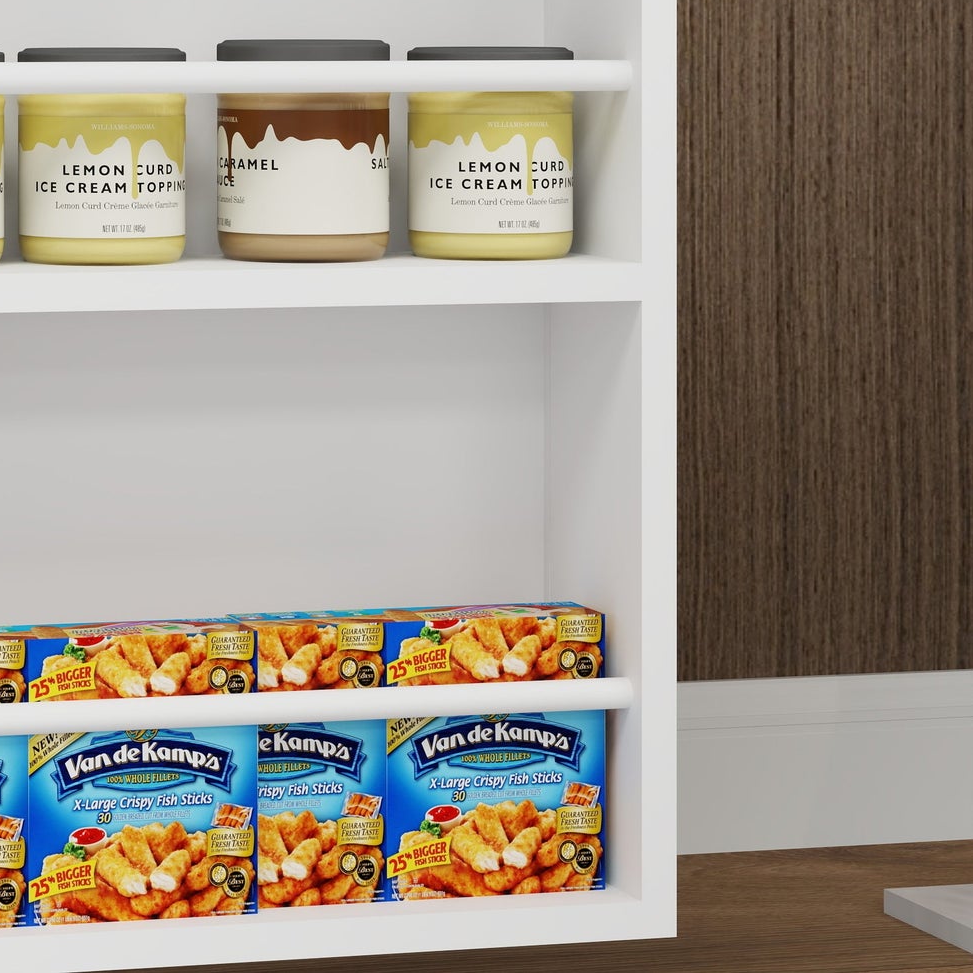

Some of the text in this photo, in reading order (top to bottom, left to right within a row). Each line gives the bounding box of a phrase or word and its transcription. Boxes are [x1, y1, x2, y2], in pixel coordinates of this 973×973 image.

[62, 164, 173, 176] LEMON CURD
[458, 160, 564, 172] LEMON CURD
[35, 179, 186, 194] ICE CREAM TOPPING
[429, 178, 452, 189] ICE
[461, 178, 522, 190] CREAM
[55, 201, 80, 210] Lemon
[81, 201, 102, 210] Curd
[451, 197, 476, 206] Lemon
[477, 197, 497, 206] Curd
[559, 619, 599, 627] GUARANTEED
[341, 627, 381, 636] GUARANTEED
[559, 626, 597, 634] FRESH TASTE
[210, 636, 251, 644] GUARANTEED
[341, 635, 362, 643] FRESH
[210, 642, 249, 651] FRESH TASTE
[2, 652, 21, 660] TASTE
[388, 648, 447, 680] 25% BIGGER
[414, 661, 447, 673] FISH STICKS
[30, 666, 92, 699] 25% BIGGER
[57, 679, 92, 692] FISH STICKS
[390, 717, 411, 736] NEW
[273, 731, 350, 762] Kamp's
[420, 721, 570, 760] Van de Kamp's
[64, 740, 220, 779] Van de Kamp's
[478, 753, 504, 763] WHOLE
[505, 752, 532, 762] FILLETS
[258, 762, 310, 774] WHOLE FILLETS
[125, 774, 151, 784] WHOLE
[151, 772, 180, 782] FILLETS
[429, 771, 562, 790] X-Large Crispy Fish Sticks
[258, 780, 343, 800] rispy Fish Sticks
[451, 790, 466, 802] 30
[73, 792, 213, 812] X-Large Crispy Fish Sticks
[97, 812, 111, 824] 30
[559, 810, 599, 819] GUARANTEED
[341, 821, 381, 830] GUARANTEED
[559, 818, 597, 826] FRESH TASTE
[210, 832, 251, 841] GUARANTEED
[341, 829, 379, 837] FRESH TASTE
[210, 839, 249, 848] FRESH TASTE
[2, 851, 21, 859] TASTE
[388, 841, 447, 874] 25% BIGGER
[414, 855, 447, 867] FISH STICKS
[30, 865, 92, 898] 25% BIGGER
[57, 878, 92, 891] FISH STICKS
